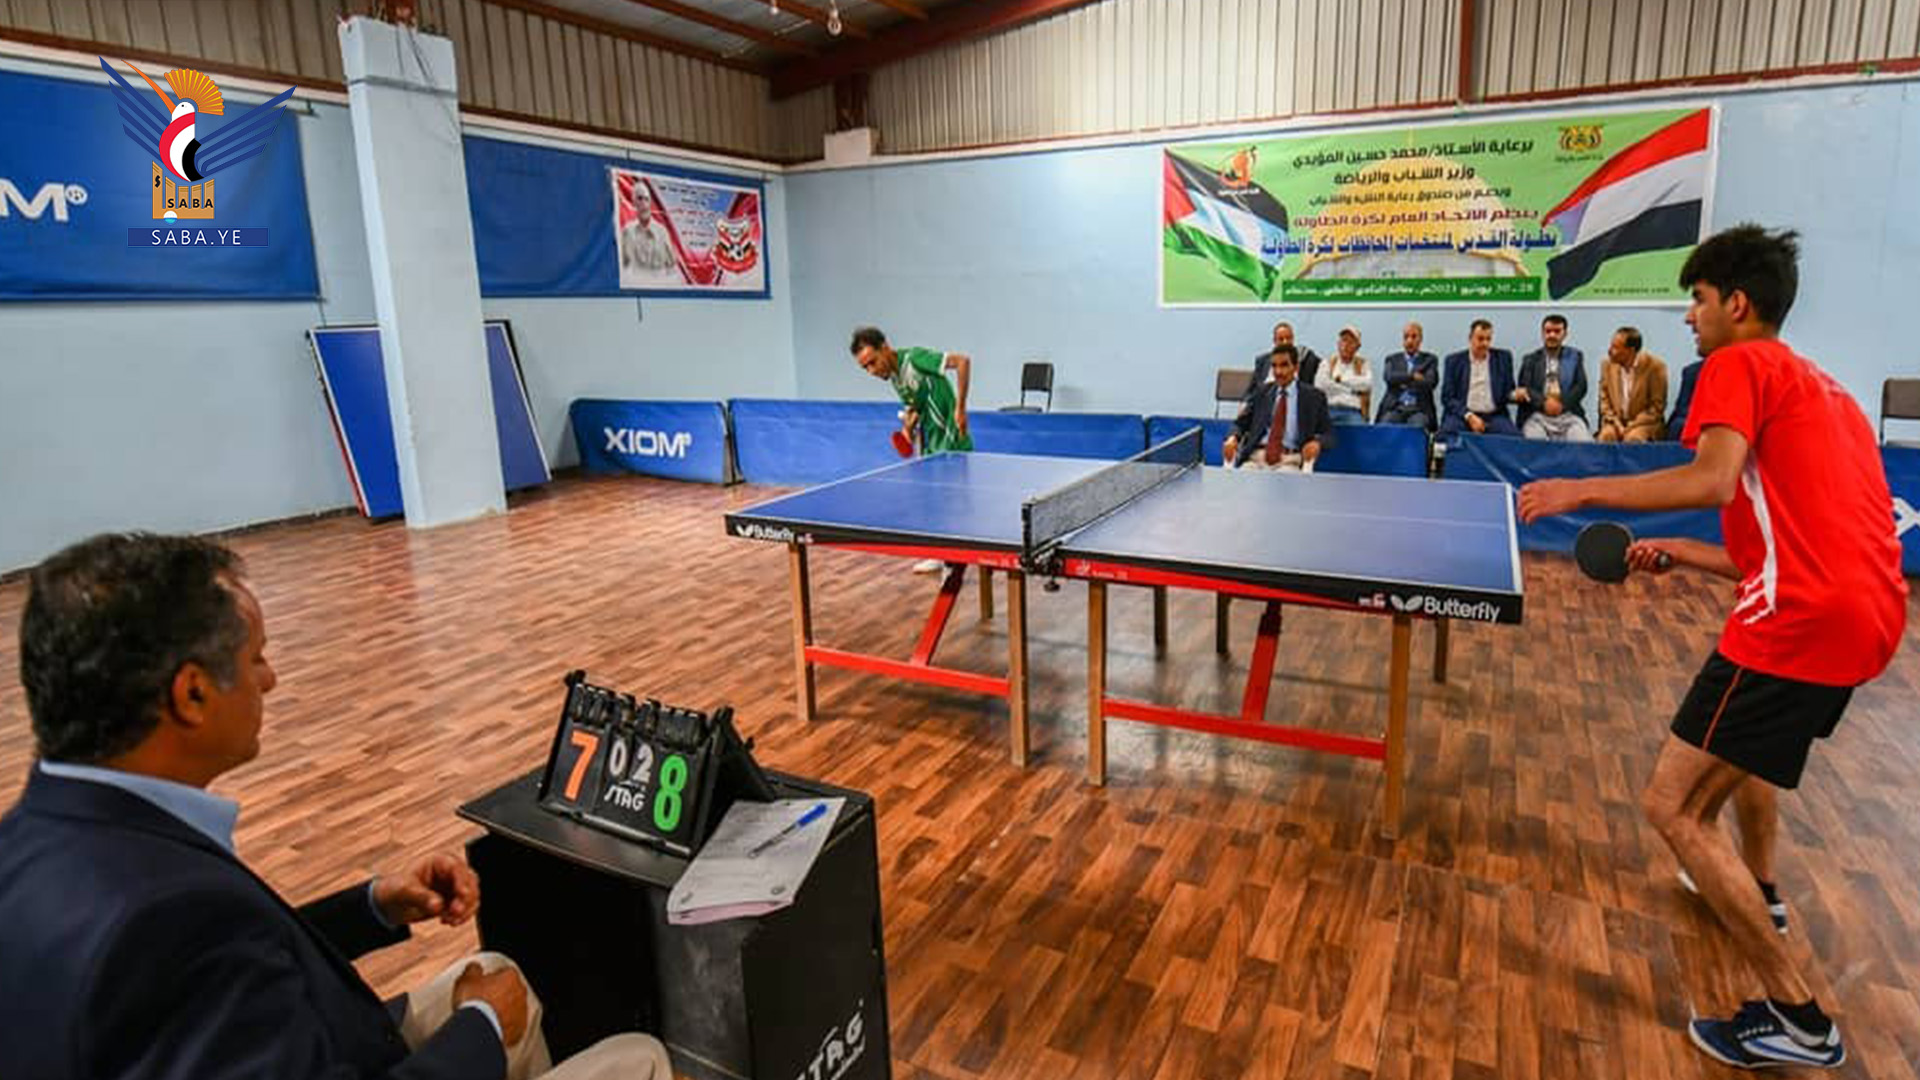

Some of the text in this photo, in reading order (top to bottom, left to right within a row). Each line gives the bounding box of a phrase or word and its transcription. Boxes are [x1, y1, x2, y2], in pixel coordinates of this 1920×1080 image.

[1333, 164, 1475, 185] وزير الشباب والرياضة
[1424, 595, 1500, 623] Butterfly
[564, 730, 599, 801] 7
[609, 740, 627, 777] 0
[631, 745, 653, 784] 2
[653, 754, 688, 831] 8
[603, 784, 646, 812] STAG
